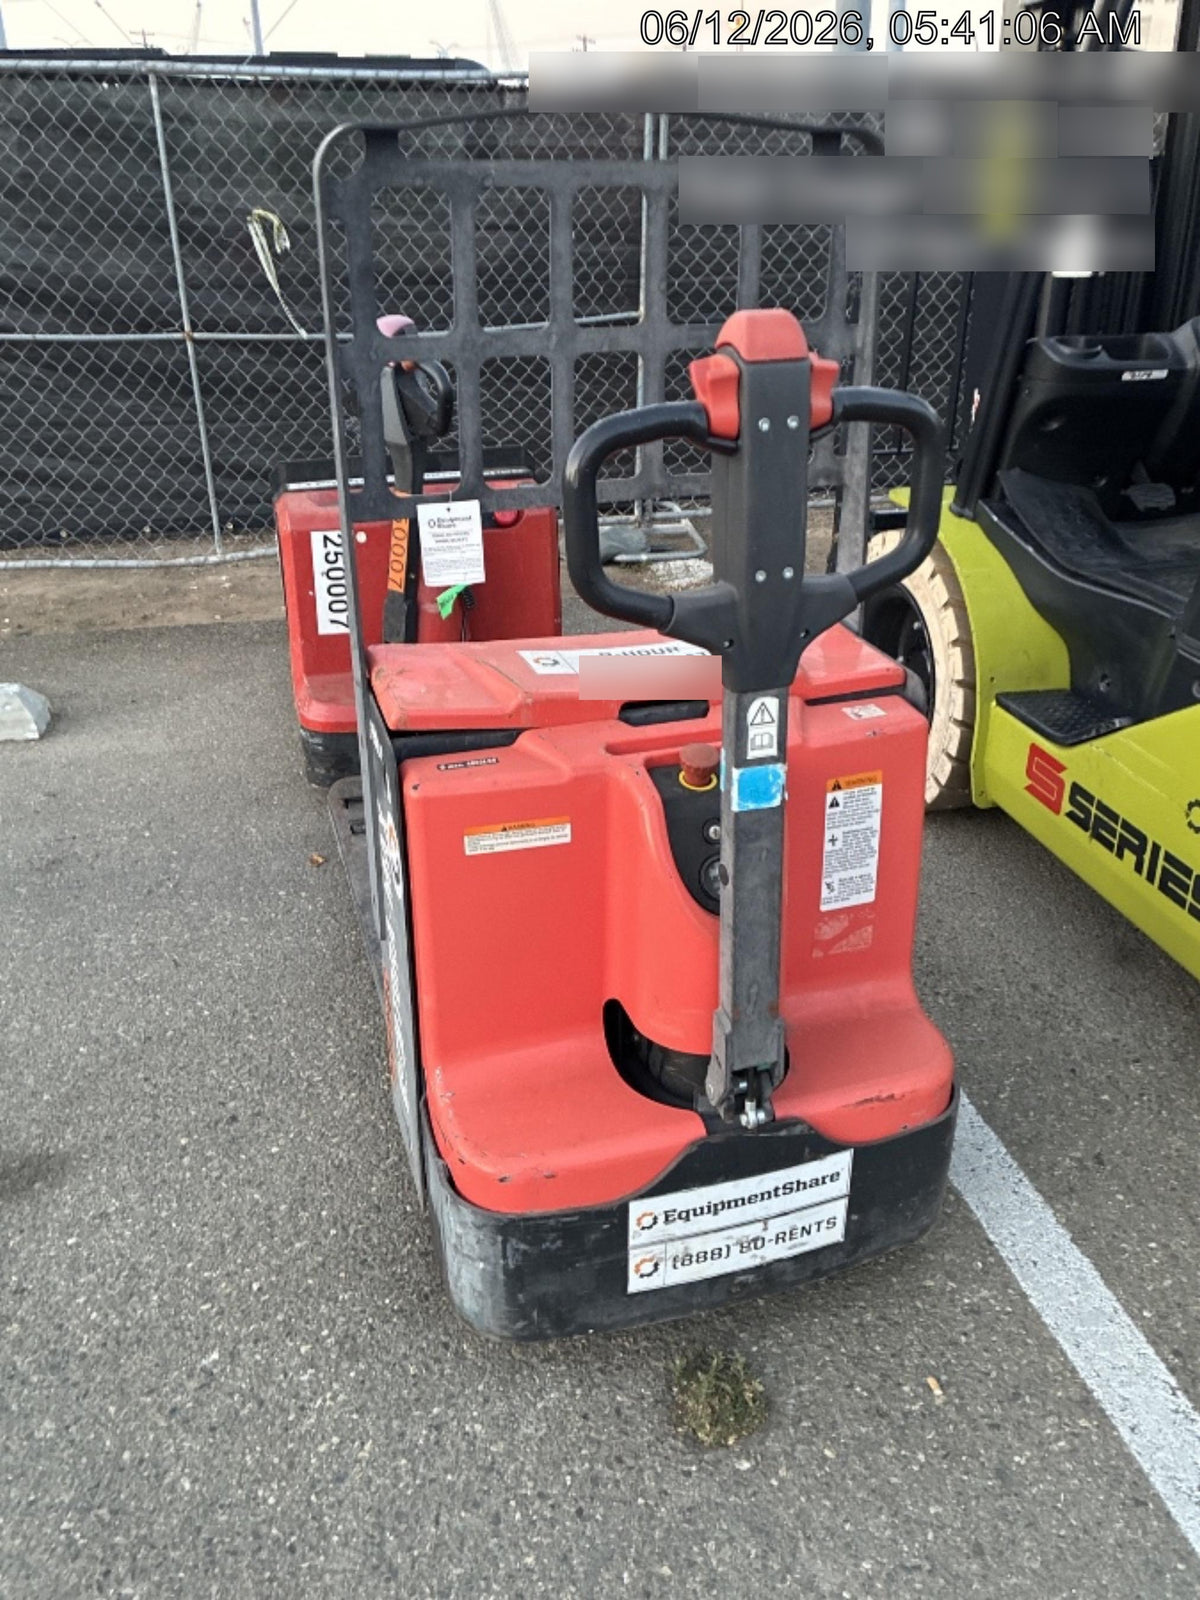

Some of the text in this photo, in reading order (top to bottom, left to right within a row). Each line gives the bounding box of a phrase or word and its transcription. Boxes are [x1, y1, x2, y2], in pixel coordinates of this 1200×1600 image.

[323, 533, 350, 628] 250007
[1024, 742, 1200, 922] S SERIE
[662, 1168, 842, 1225] EquipmentShare
[671, 1216, 838, 1271] (888) 80-RENTS
